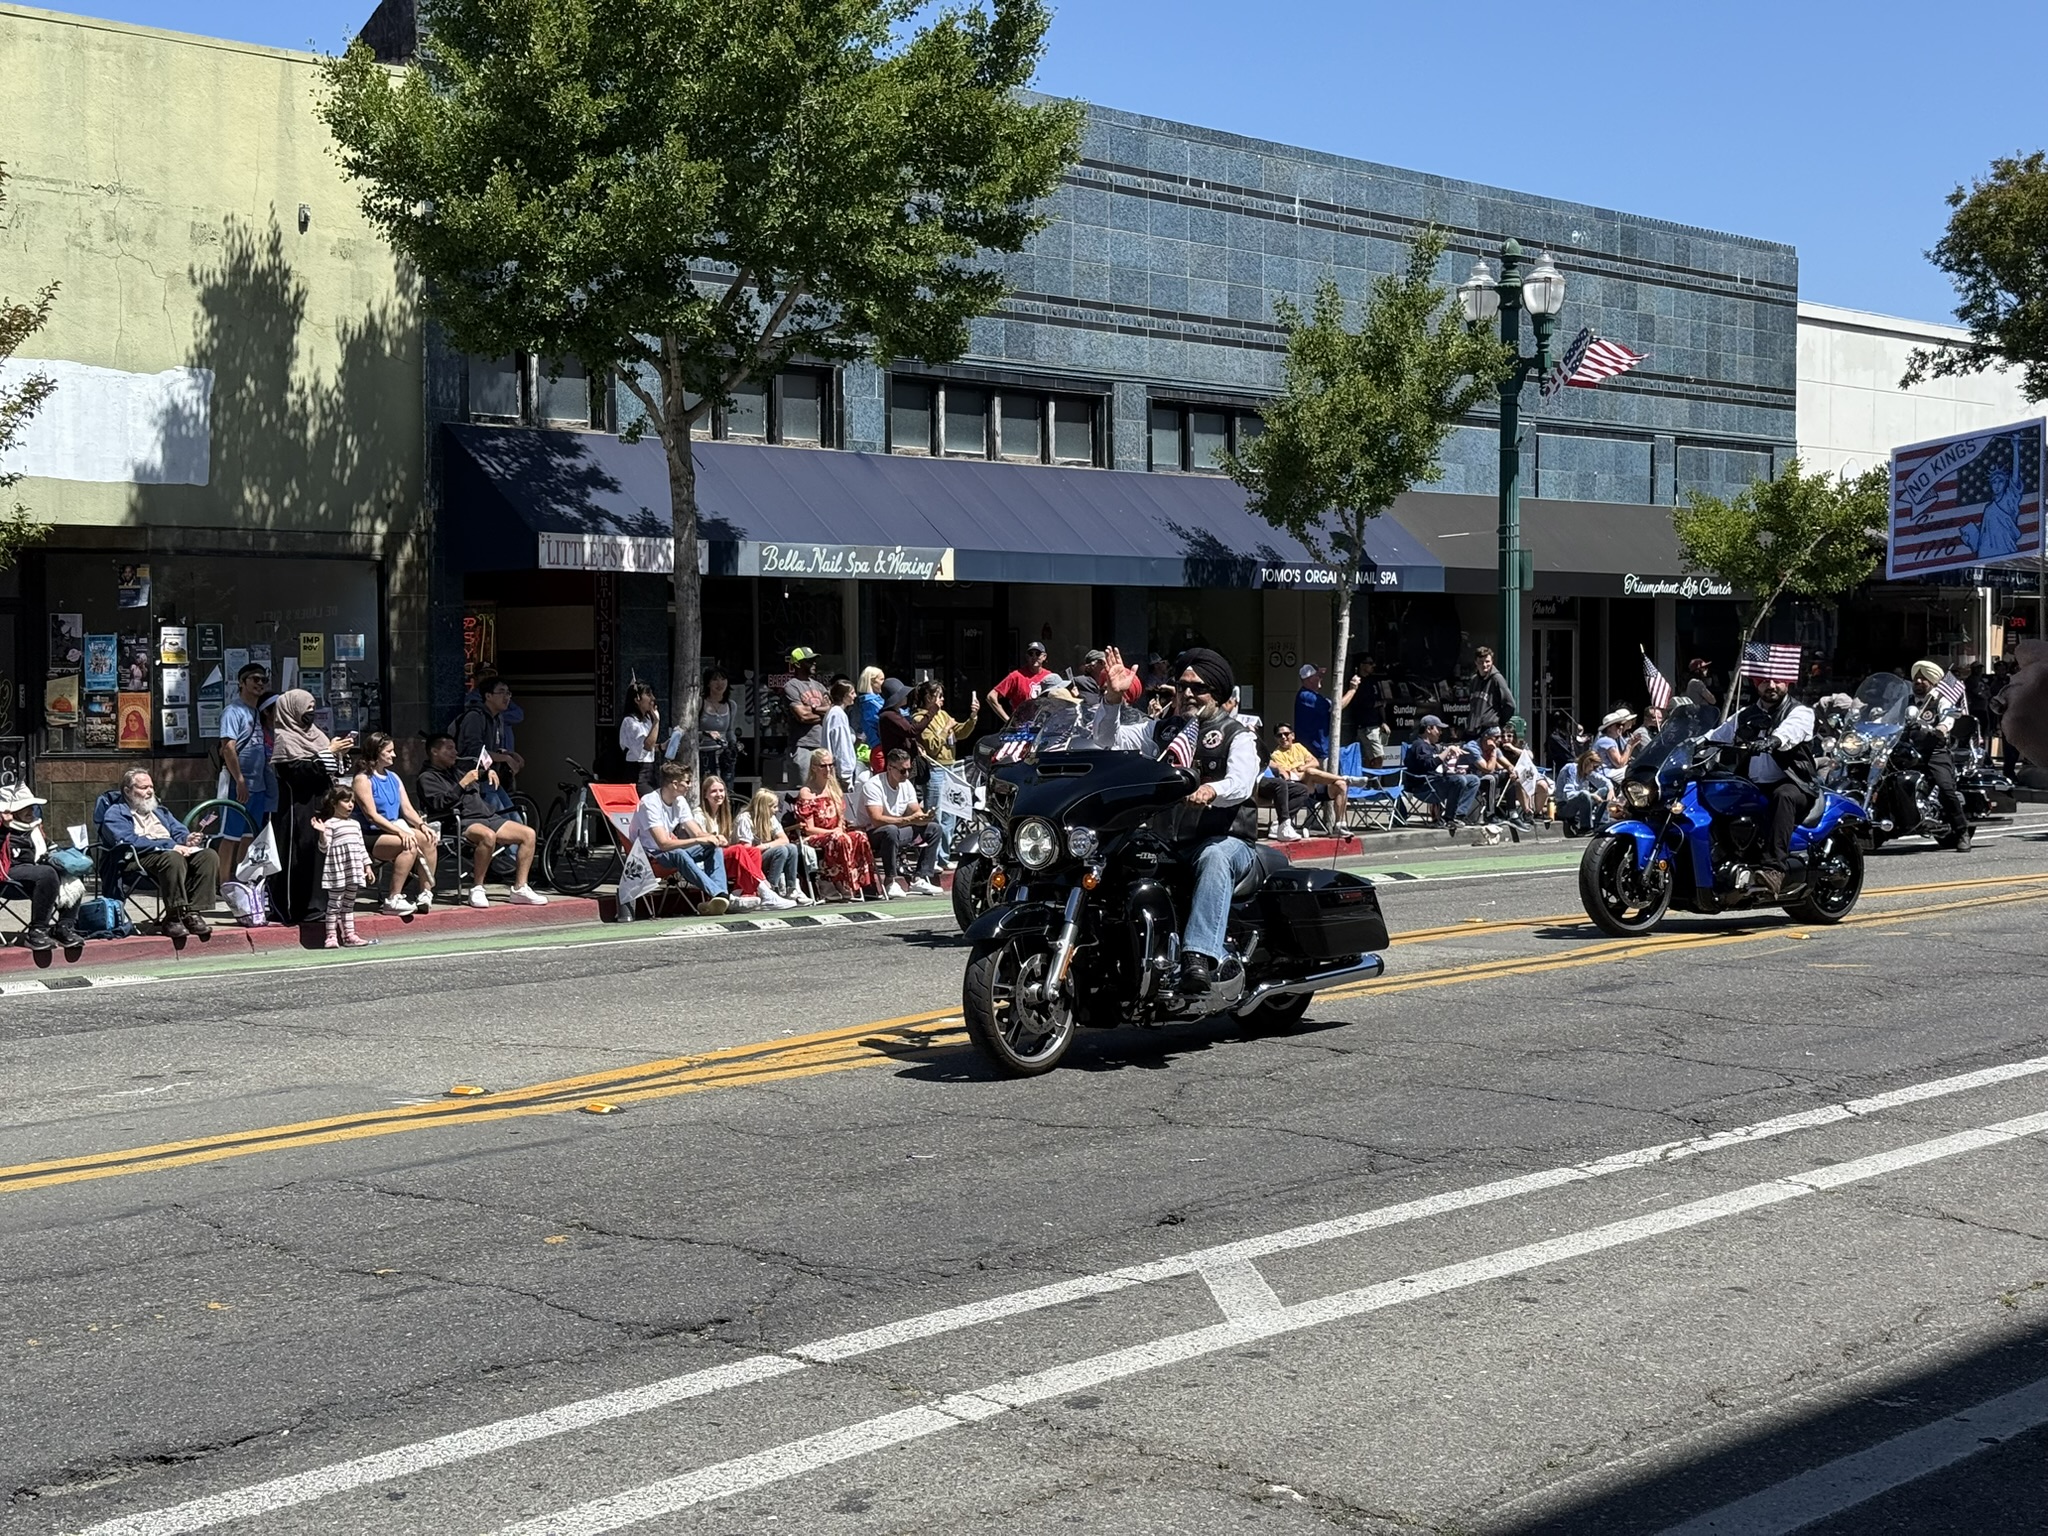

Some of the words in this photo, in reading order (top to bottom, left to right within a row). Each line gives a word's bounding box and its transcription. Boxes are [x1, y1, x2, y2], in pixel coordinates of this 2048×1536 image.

[1907, 472, 1930, 497] NO
[1930, 439, 1977, 475] KINGS
[546, 539, 599, 567] LITTLE
[762, 545, 806, 572] Bella
[806, 547, 842, 573] Nail
[845, 551, 870, 577] Spa
[874, 550, 886, 574] &
[887, 550, 934, 580] Waxing
[1261, 568, 1301, 583] TOMO'S
[1355, 571, 1377, 584] NAIL
[1380, 571, 1398, 585] SPA
[1623, 573, 1680, 598] Triumphant
[1679, 576, 1698, 599] Life
[1699, 577, 1732, 597] Church
[303, 636, 320, 644] IMP
[1393, 704, 1417, 716] Sunday
[1442, 703, 1471, 713] Wednesd
[1395, 717, 1404, 727] 10
[1404, 719, 1415, 727] am
